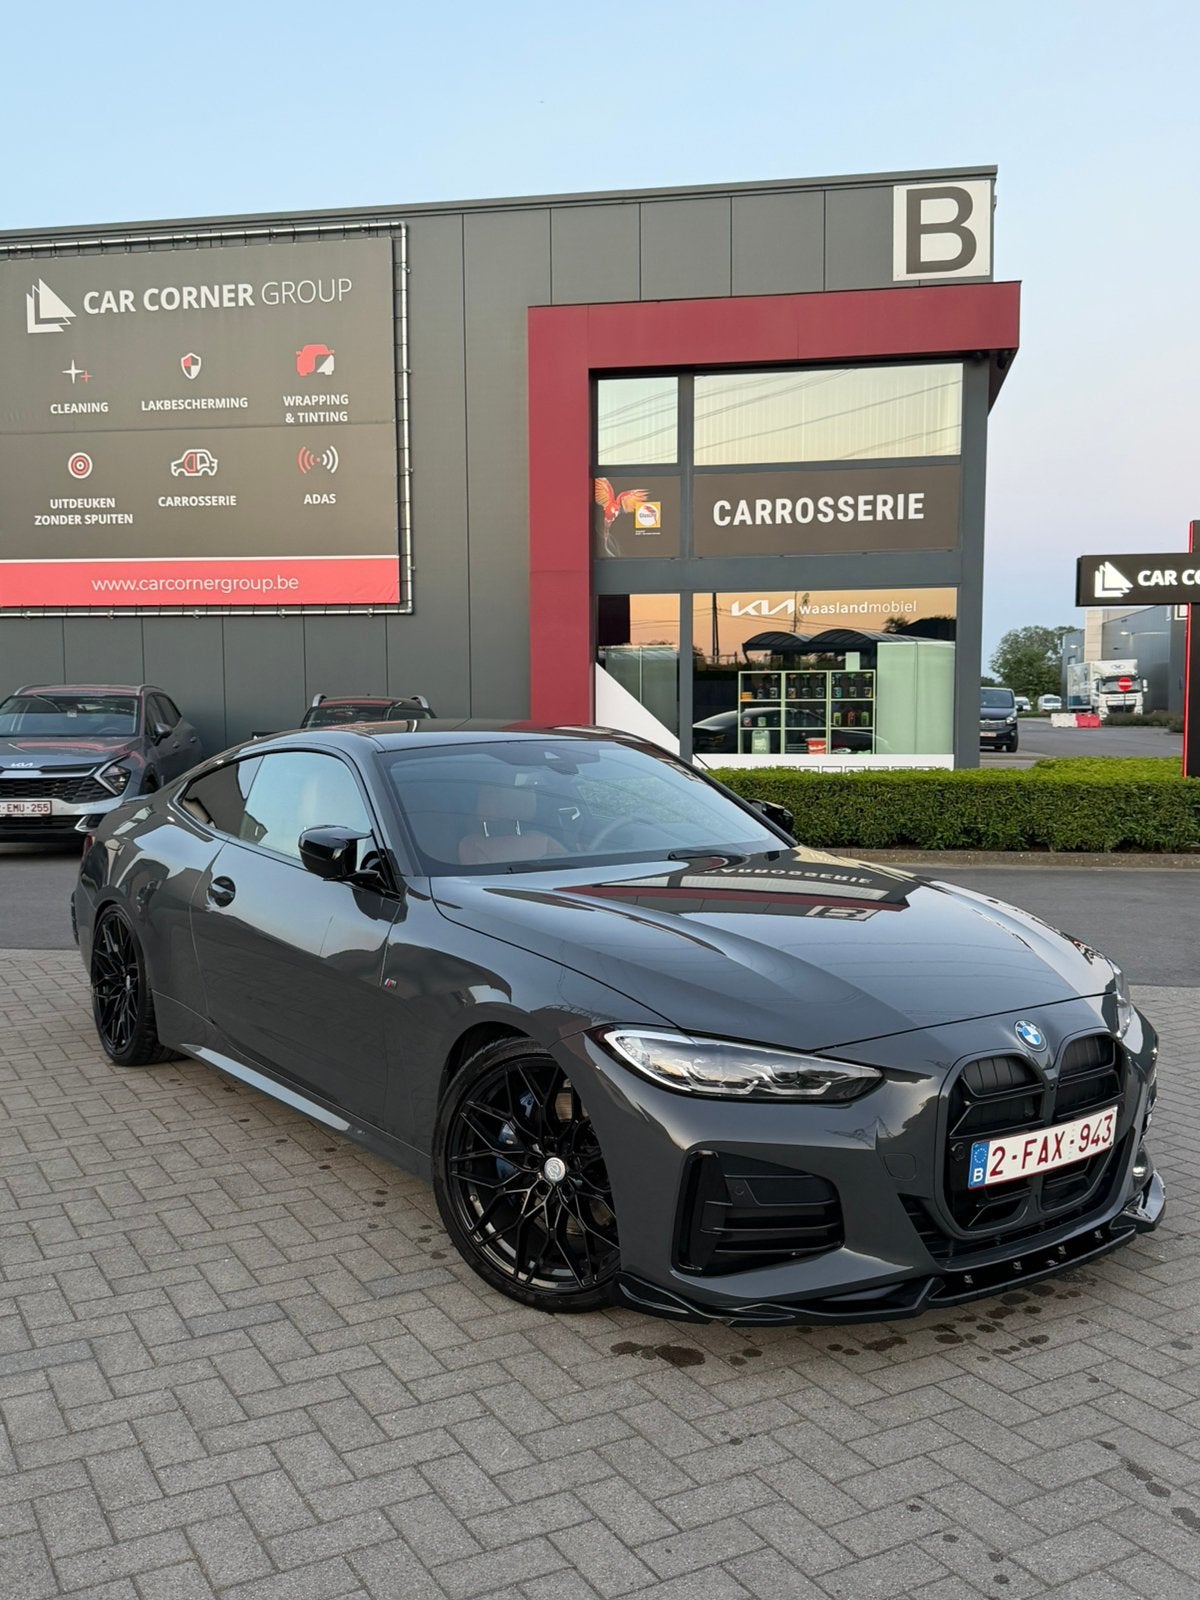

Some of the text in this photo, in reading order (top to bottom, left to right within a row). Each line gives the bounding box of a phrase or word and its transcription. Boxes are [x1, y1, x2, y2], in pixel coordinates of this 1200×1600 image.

[906, 186, 977, 274] B
[83, 278, 353, 315] CAR CORNER GROUP
[141, 397, 249, 411] LAKBESCHERMING
[283, 393, 349, 407] WRAPPING
[50, 402, 109, 414] CLEANING
[285, 411, 348, 424] & TINTING
[50, 497, 116, 509] UITDEUKEN
[158, 495, 237, 507] CARROSSERIE
[303, 493, 337, 505] ADAS
[713, 493, 925, 526] CARROSSERIE
[34, 513, 134, 526] ZONDER SPUITEN
[91, 574, 299, 594] www.carcornergroup.be
[1137, 569, 1178, 587] CAR
[799, 600, 917, 615] waaslandmobiel
[0, 803, 49, 813] -EMU-255
[989, 1114, 1114, 1177] 2-FAX-943
[973, 1168, 984, 1182] B
